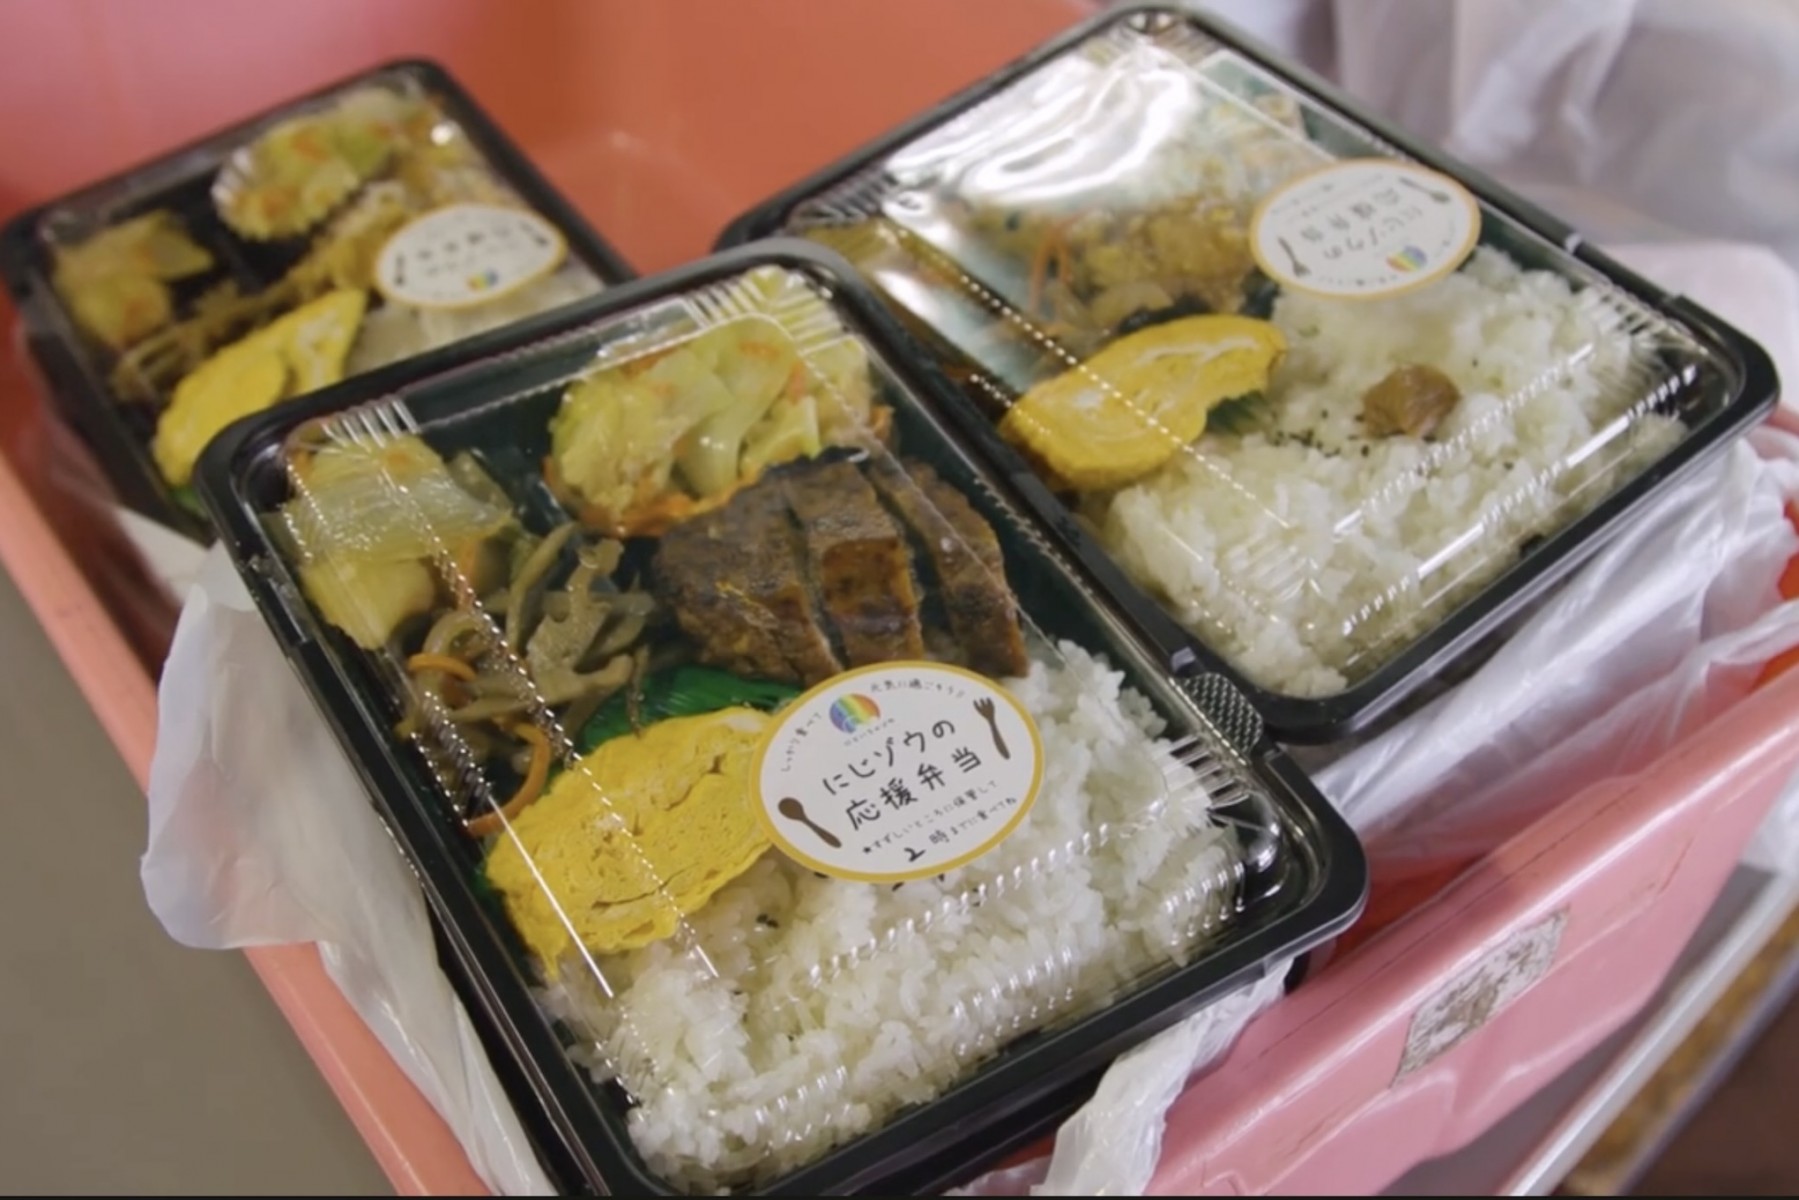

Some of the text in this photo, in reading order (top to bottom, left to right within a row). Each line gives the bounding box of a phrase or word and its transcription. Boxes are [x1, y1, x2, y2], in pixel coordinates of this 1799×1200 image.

[822, 719, 956, 795] にじゾウの
[845, 747, 982, 830] 応援弁当
